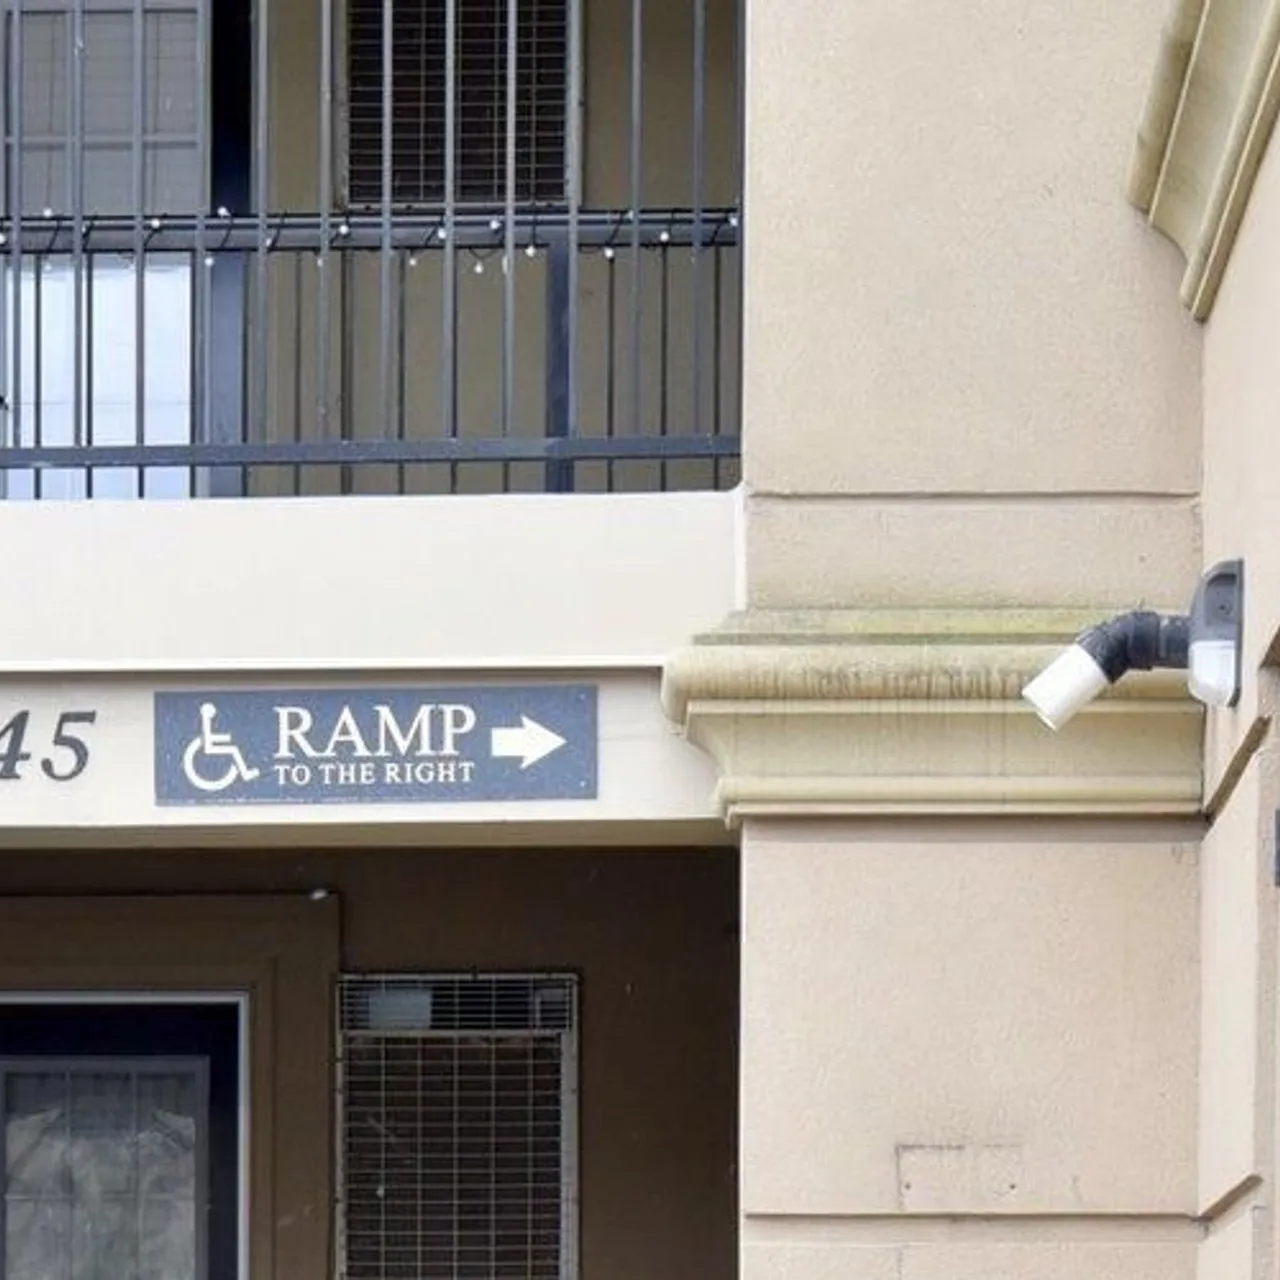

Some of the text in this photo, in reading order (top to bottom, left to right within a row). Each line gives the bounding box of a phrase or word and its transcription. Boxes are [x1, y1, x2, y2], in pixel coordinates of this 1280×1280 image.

[273, 703, 476, 759] RAMP
[274, 761, 475, 786] TO THE RIGHT
